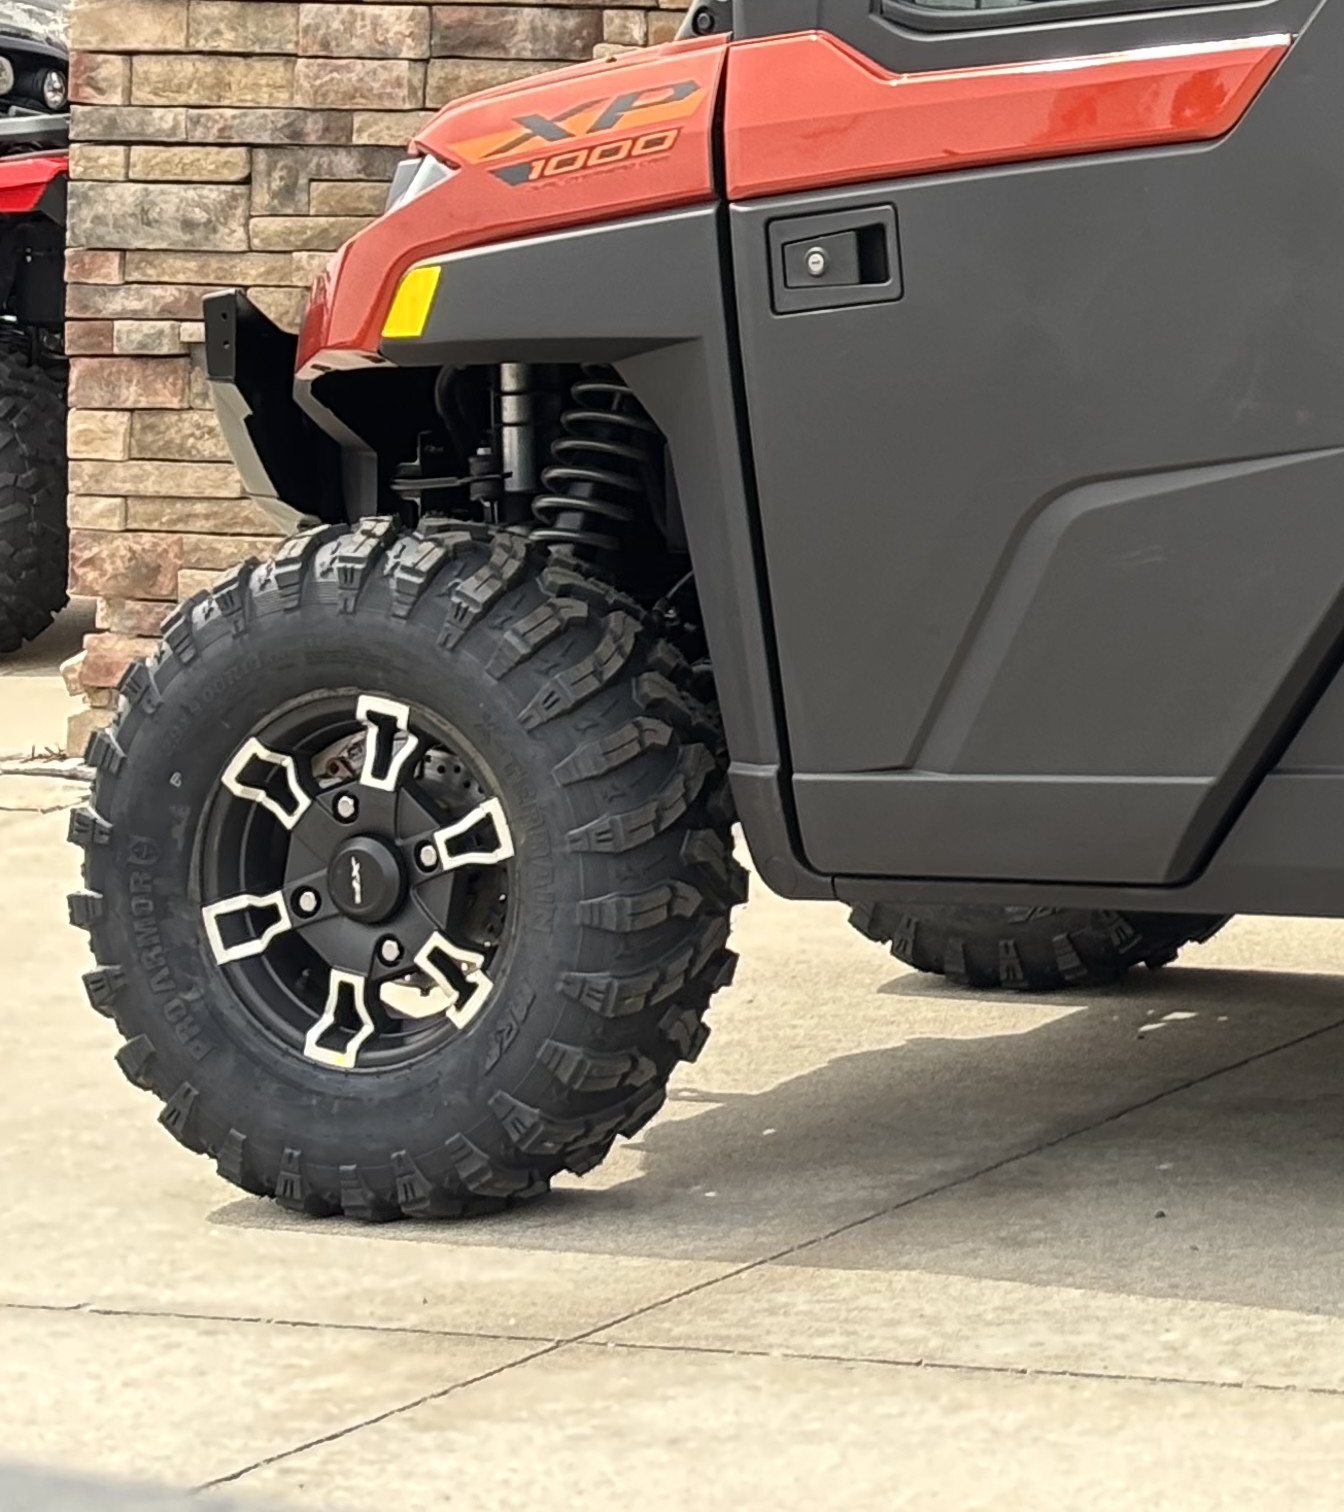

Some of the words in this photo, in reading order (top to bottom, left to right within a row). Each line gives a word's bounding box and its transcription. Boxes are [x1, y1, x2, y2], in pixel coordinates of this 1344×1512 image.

[479, 80, 701, 159] XP
[527, 128, 681, 181] 1000
[129, 870, 177, 994] ARMOR
